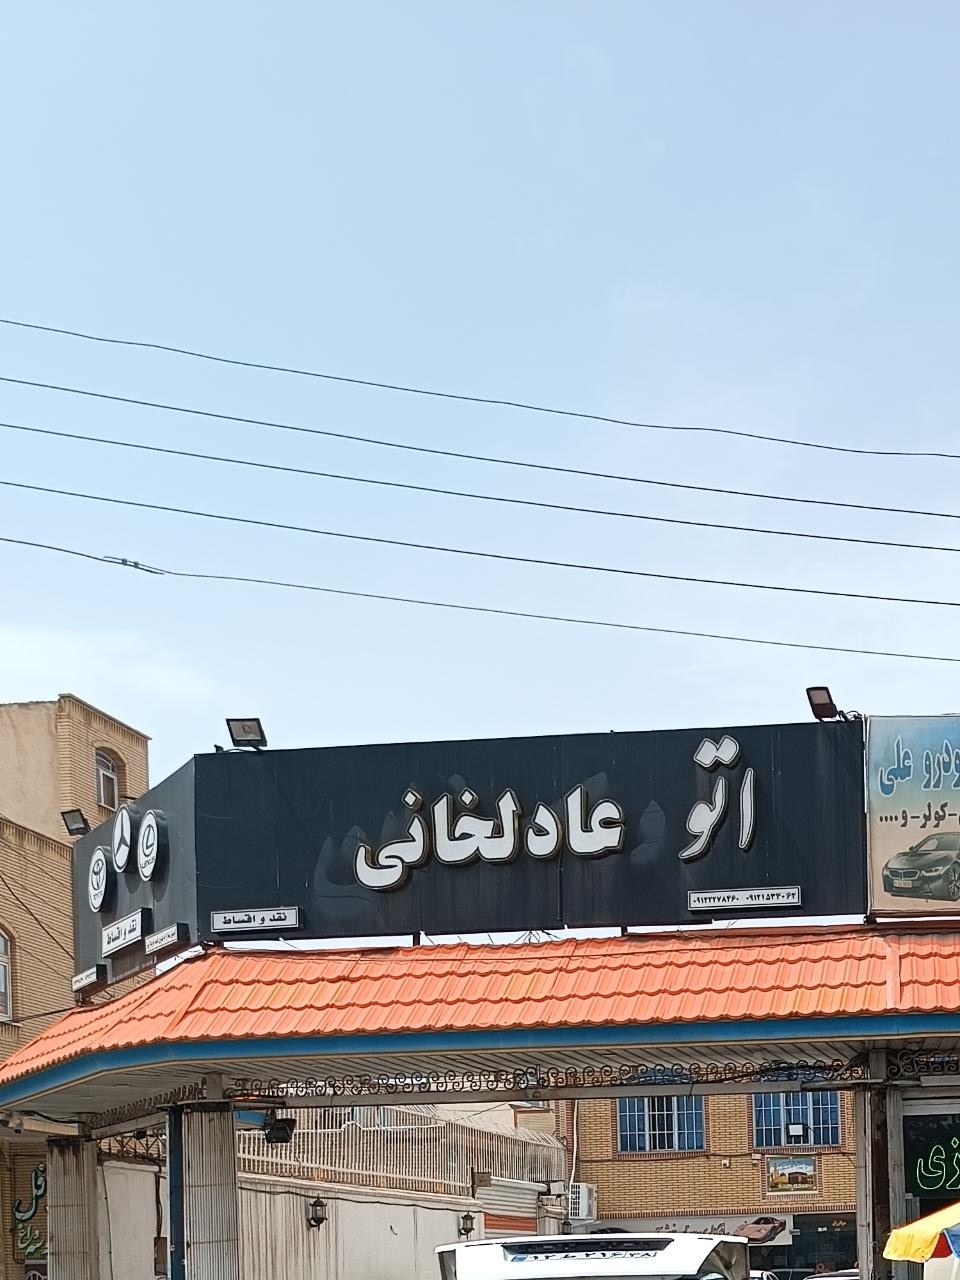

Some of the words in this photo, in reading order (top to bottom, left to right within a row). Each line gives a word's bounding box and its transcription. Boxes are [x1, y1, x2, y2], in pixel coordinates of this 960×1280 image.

[878, 736, 913, 797] علی
[679, 735, 754, 861] اتو
[223, 914, 255, 924] اقساط
[260, 916, 265, 924] و
[269, 912, 287, 922] نقد
